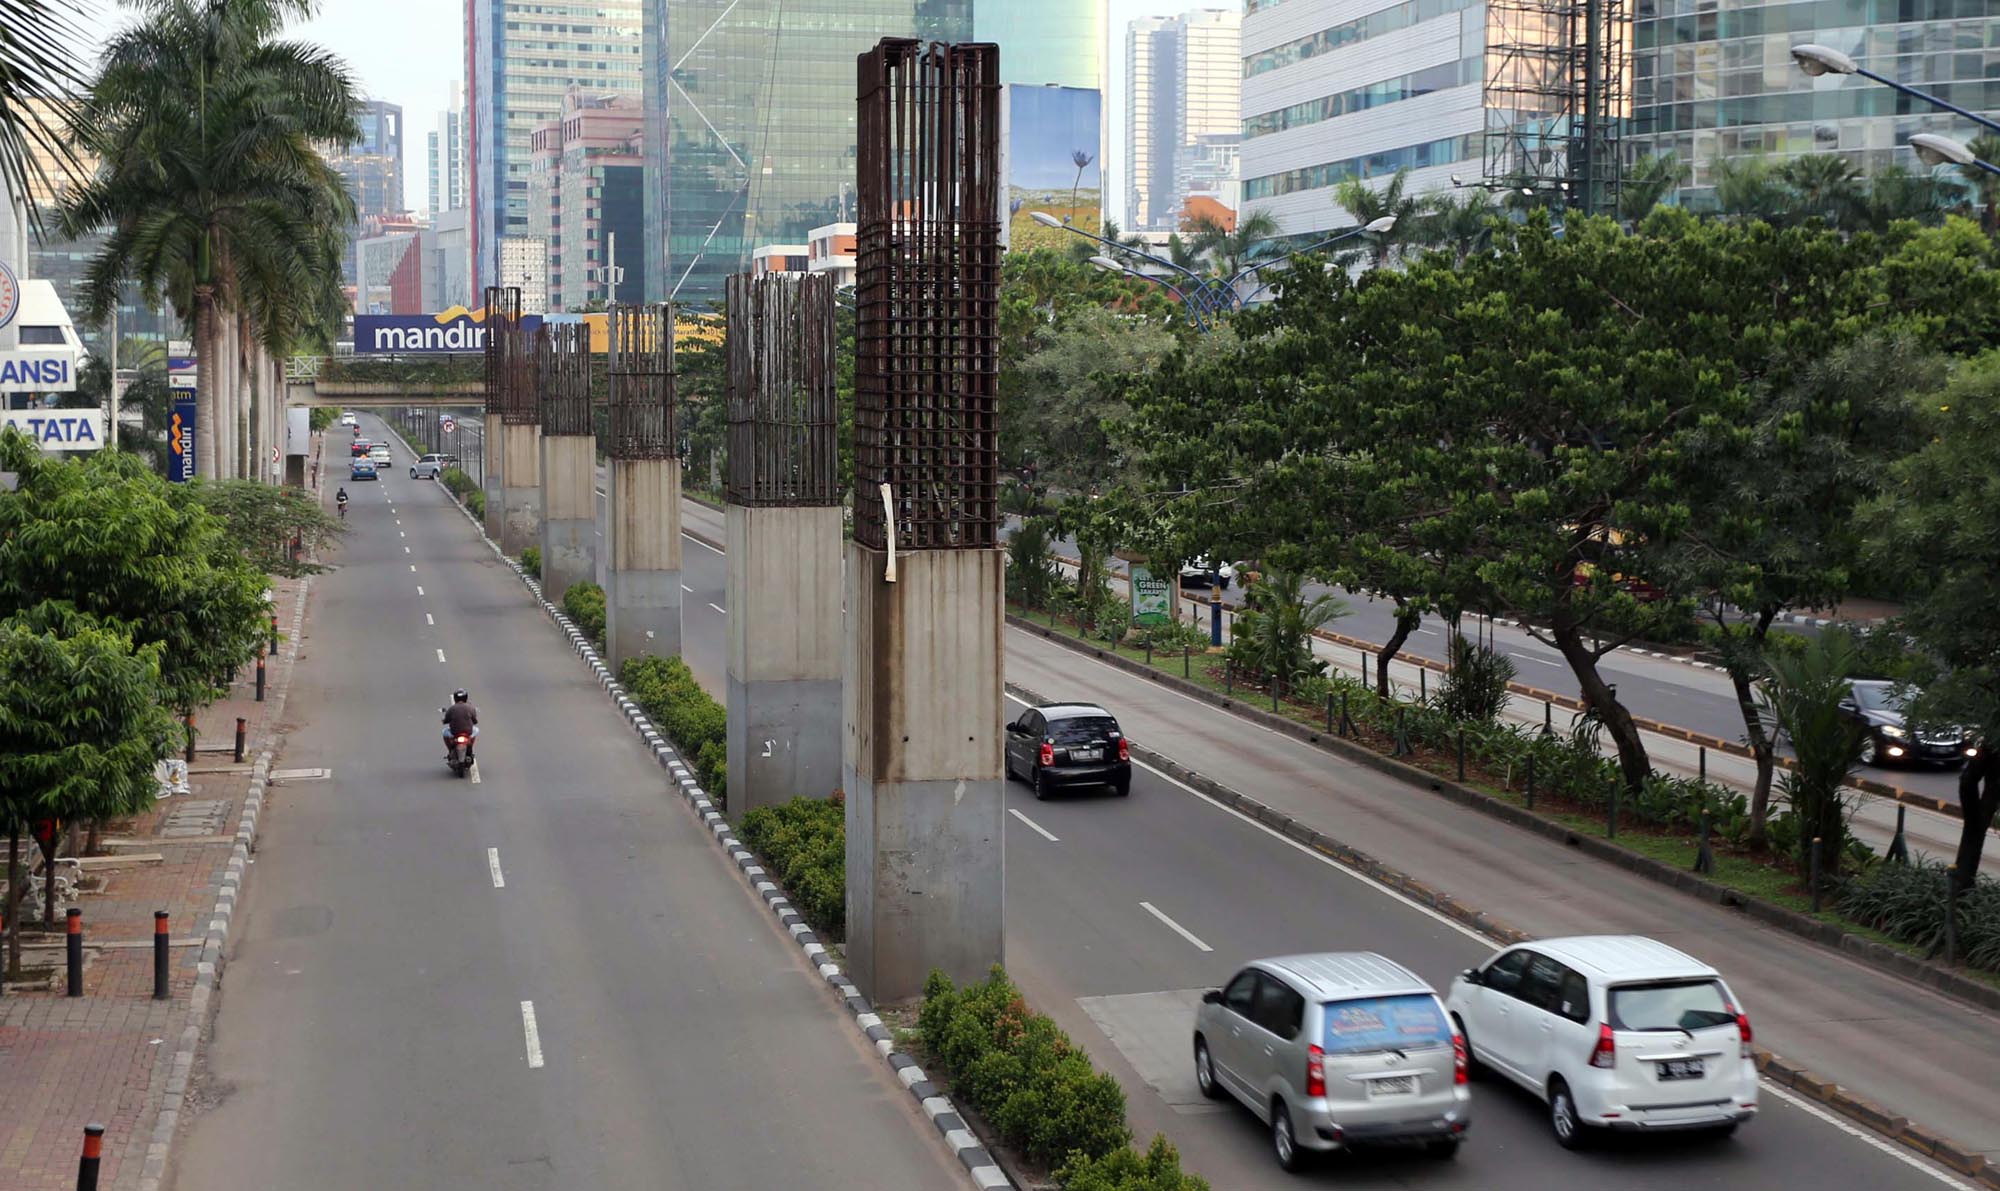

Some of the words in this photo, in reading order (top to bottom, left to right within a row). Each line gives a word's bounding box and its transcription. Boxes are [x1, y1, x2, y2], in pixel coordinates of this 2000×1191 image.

[0, 359, 68, 384] ANSI
[27, 418, 96, 442] TATA
[179, 427, 192, 479] mandiri
[1139, 581, 1167, 589] GREEN
